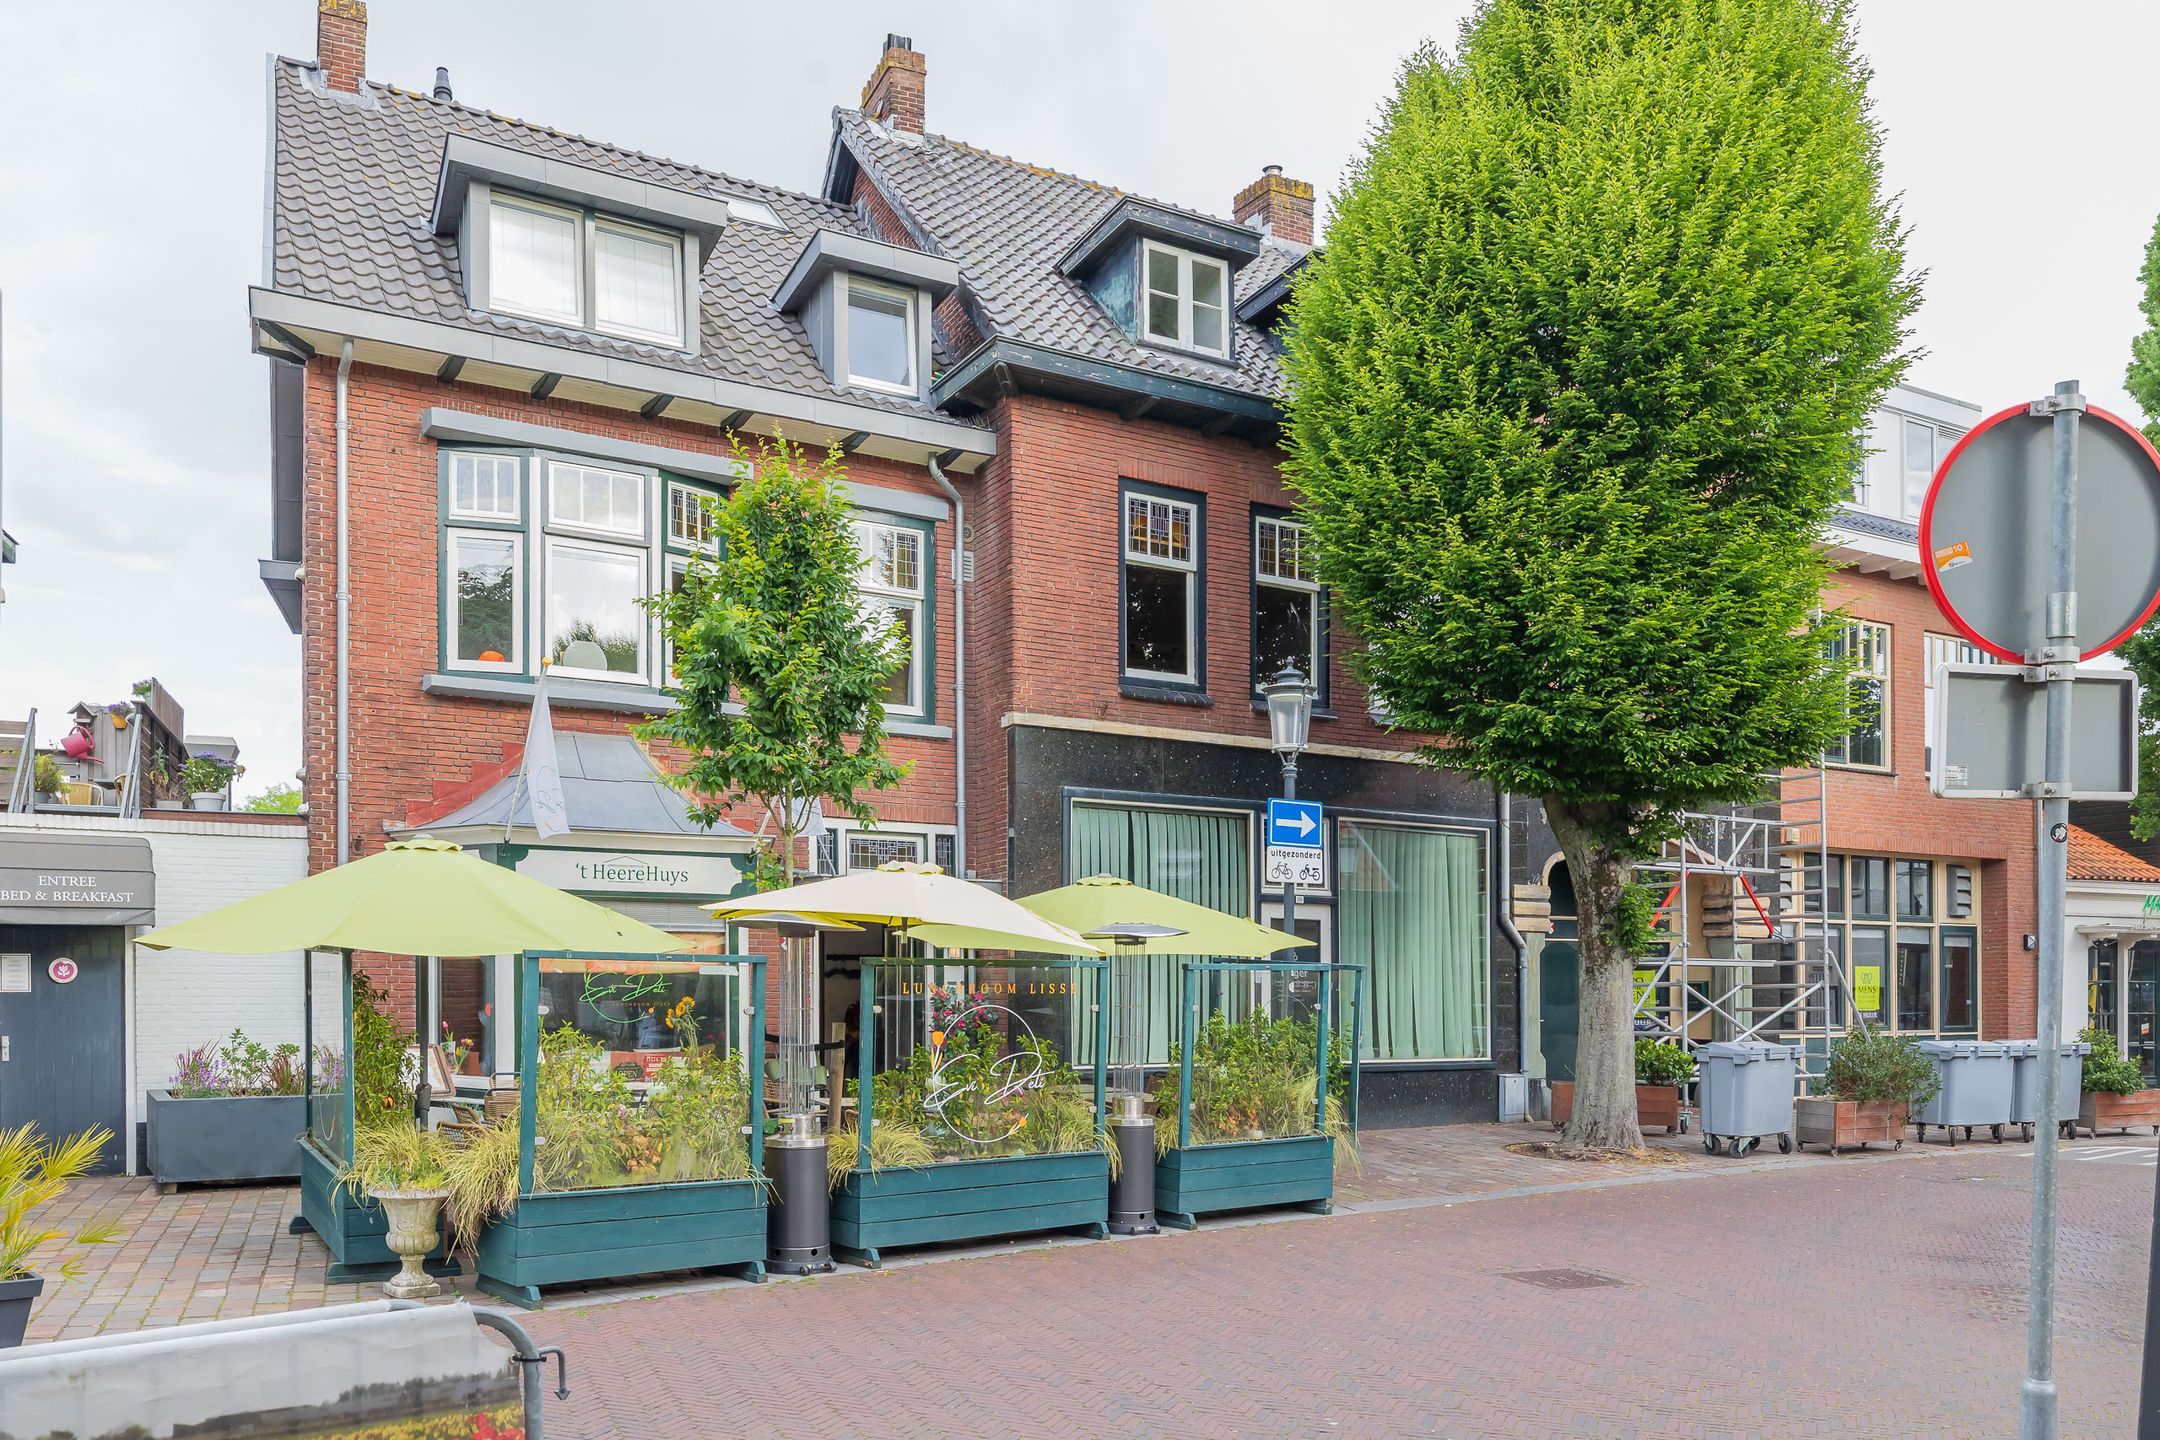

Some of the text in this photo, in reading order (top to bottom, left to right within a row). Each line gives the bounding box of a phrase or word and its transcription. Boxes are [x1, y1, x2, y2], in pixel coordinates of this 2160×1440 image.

[1270, 849, 1321, 860] uitgezonderd
[593, 863, 689, 886] HeereHuys
[38, 875, 97, 887] ENTREE
[0, 890, 134, 902] BED & BREAKFAST
[902, 982, 1077, 995] LUNCHROOM LISSE
[923, 1053, 980, 1108] Evi
